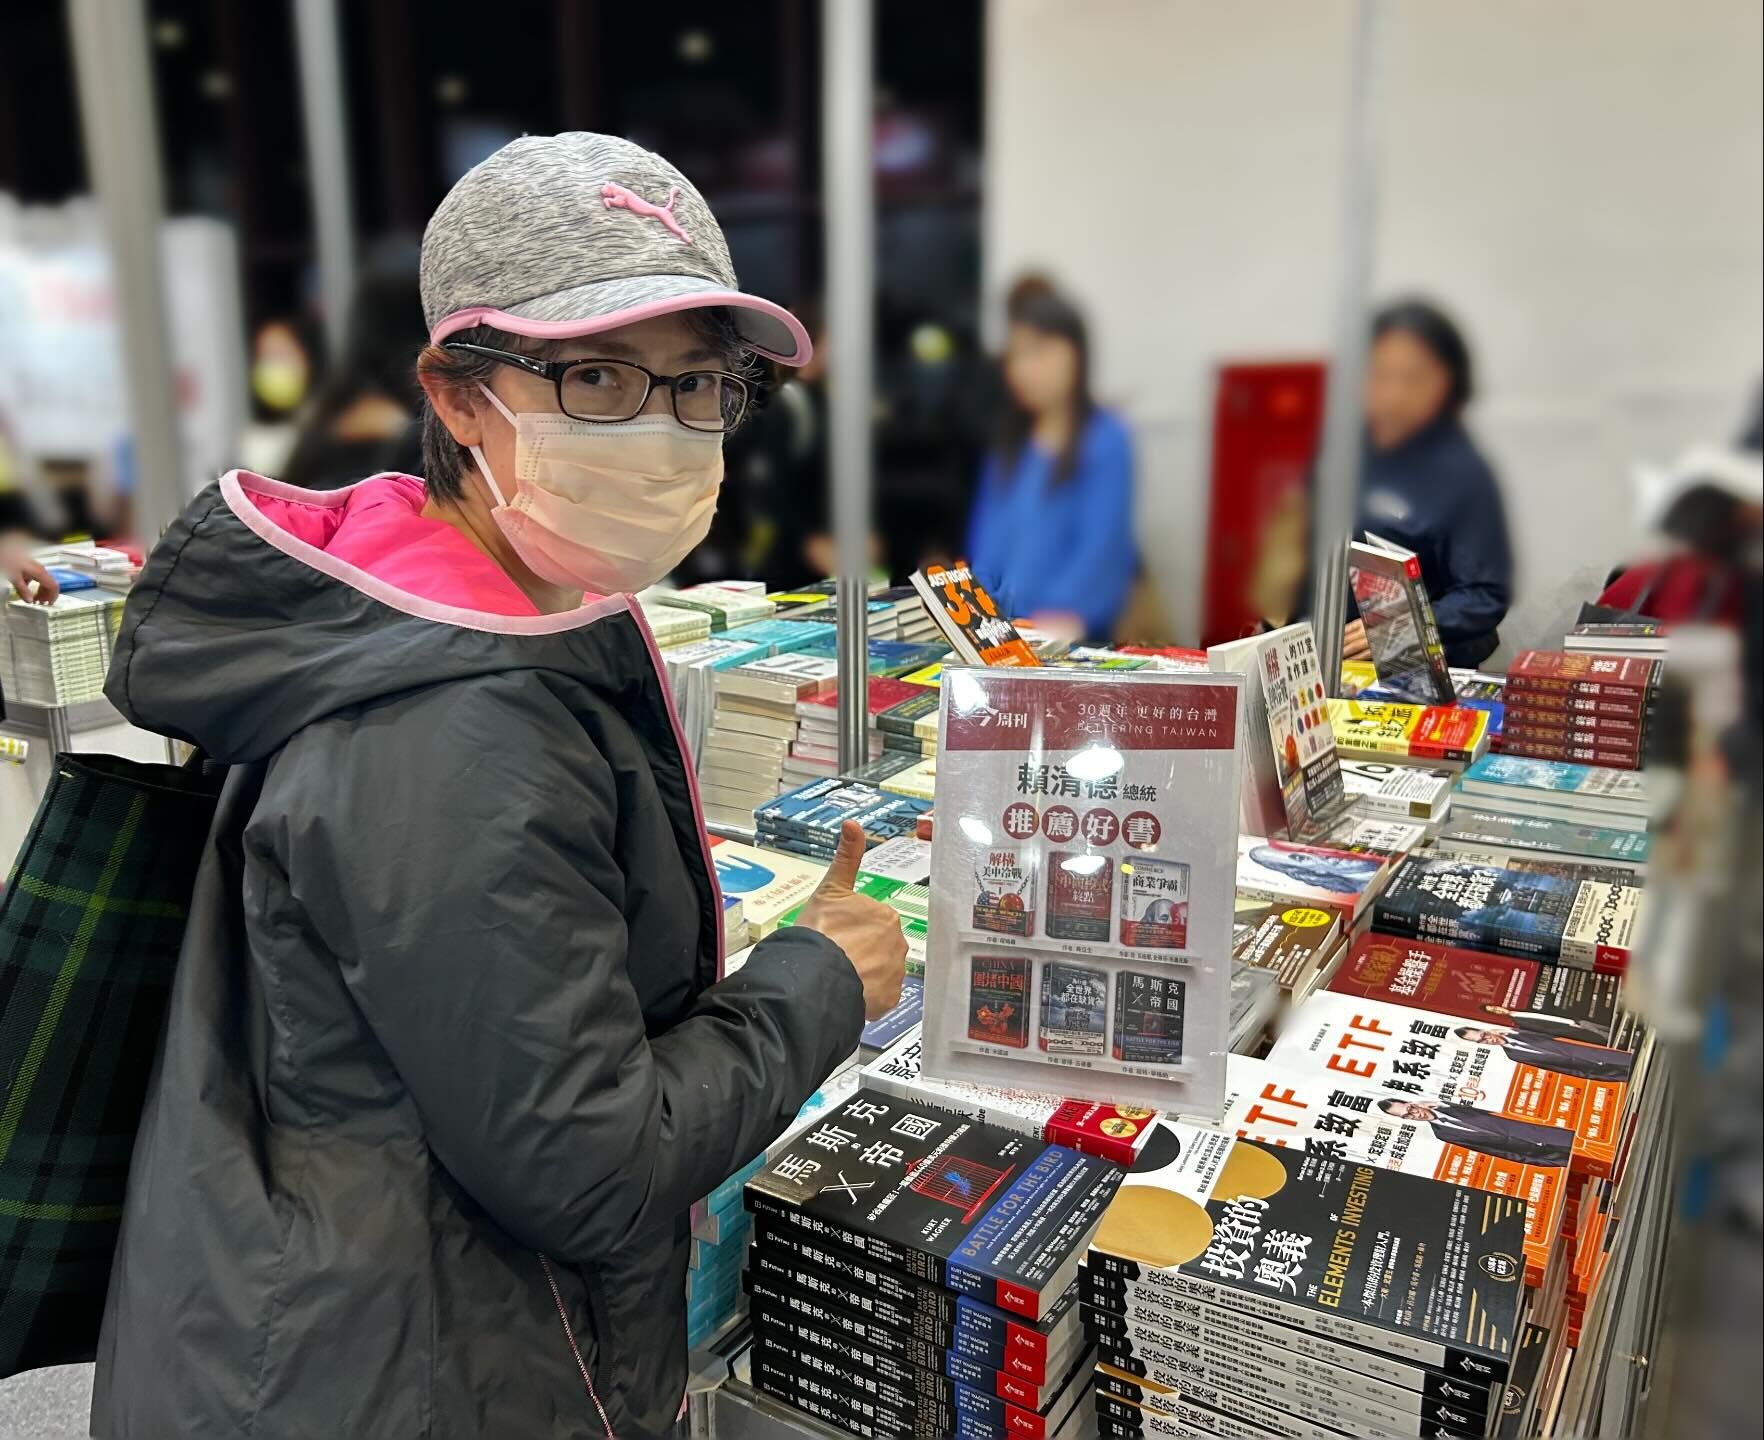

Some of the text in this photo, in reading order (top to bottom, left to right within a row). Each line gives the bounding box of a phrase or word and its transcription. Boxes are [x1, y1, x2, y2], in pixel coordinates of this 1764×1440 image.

[1137, 705, 1217, 721] 更好的台灣
[1162, 726, 1217, 738] TAIWAN
[1122, 784, 1157, 802] 總統
[1005, 807, 1157, 845] 推薦好書
[983, 866, 1023, 879] 美中冷戰
[989, 853, 1016, 866] 解構
[1132, 875, 1178, 892] 商業爭霸
[1429, 872, 1470, 901] 全世界
[974, 972, 1025, 990] 圍堵中國
[1132, 975, 1179, 994] 馬斯克
[1382, 948, 1439, 995] 基金操盤手
[1066, 983, 1092, 995] 全世界
[1320, 1013, 1404, 1079] ETF
[764, 1096, 892, 1185] 馬斯克
[959, 1149, 1065, 1258] BATTLE FOR THE BIRD
[919, 1218, 940, 1235] KURT
[924, 1217, 953, 1243] WAGNER
[1193, 1192, 1273, 1280] 投資的
[1313, 1227, 1359, 1307] ELEMENTS
[1339, 1165, 1376, 1227] INVESTING
[917, 1252, 925, 1278] BIRD
[1246, 1226, 1316, 1295] 奧義
[1305, 1212, 1339, 1297] THE OF
[1147, 1270, 1215, 1300] 投資的奧義
[928, 1291, 936, 1317] BIRD
[1134, 1286, 1200, 1318] 投資的奧義
[925, 1316, 933, 1341] BIRD
[1133, 1305, 1200, 1339] 投資的奧義
[917, 1342, 925, 1366] BIRD
[1133, 1326, 1200, 1359] 投資的奧義
[1139, 1347, 1205, 1379] 投資的奧義
[926, 1373, 934, 1397] BIRD
[1153, 1370, 1218, 1403] 投資的奧義
[928, 1400, 937, 1425] BIRD
